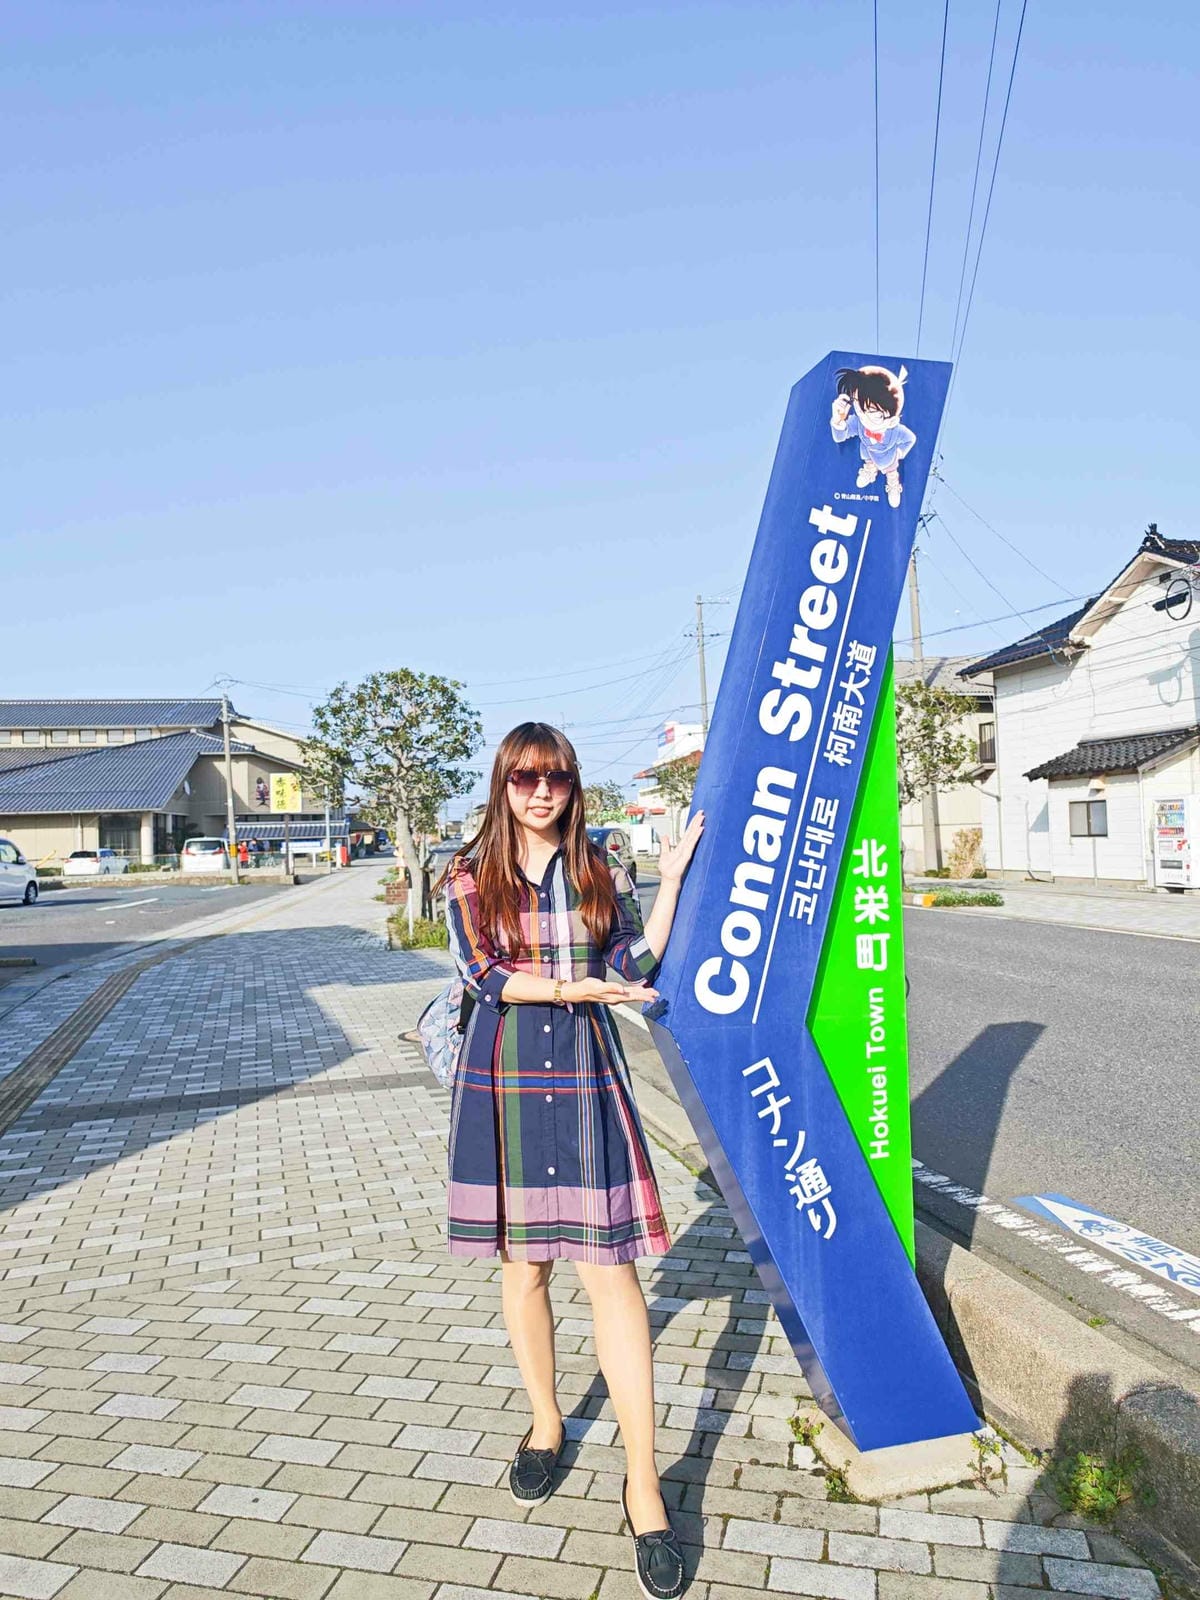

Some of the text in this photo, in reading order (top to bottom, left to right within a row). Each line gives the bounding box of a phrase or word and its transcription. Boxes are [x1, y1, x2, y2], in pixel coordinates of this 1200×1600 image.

[694, 504, 858, 1015] Conan Street
[823, 639, 877, 767] 柯南大道
[788, 796, 840, 925] 코난대로
[853, 838, 890, 971] 北栄町
[742, 1056, 837, 1241] コナン通り
[865, 987, 890, 1160] Hokuei Town
